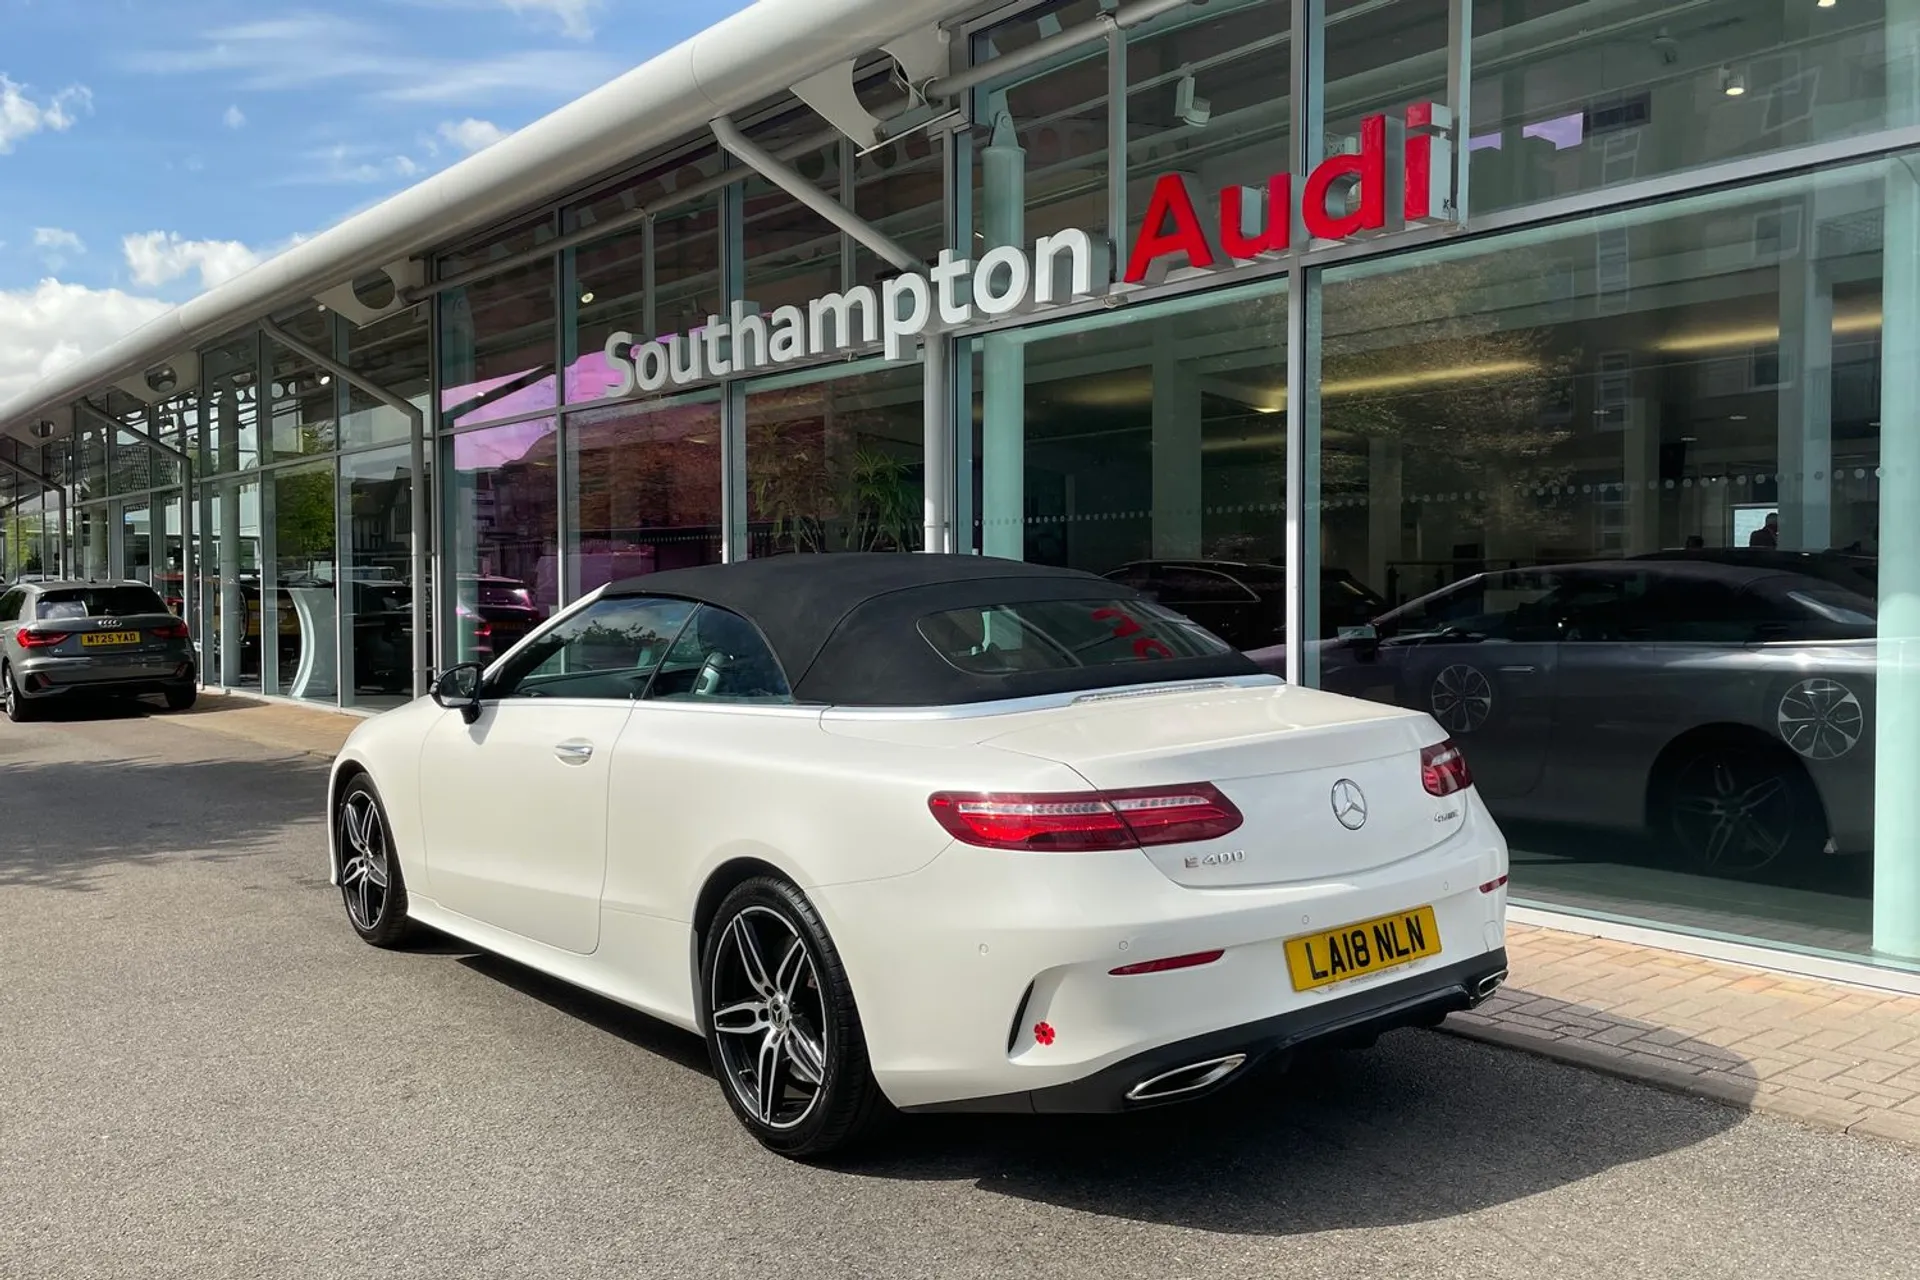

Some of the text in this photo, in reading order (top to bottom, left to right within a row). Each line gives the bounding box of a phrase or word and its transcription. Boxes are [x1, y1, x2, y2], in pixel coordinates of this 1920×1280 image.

[604, 100, 1434, 398] Southampton Audi
[87, 631, 136, 644] MT25 YAD
[1184, 849, 1246, 869] E 400
[1305, 929, 1371, 980] LA18
[1373, 914, 1426, 962] NLN
